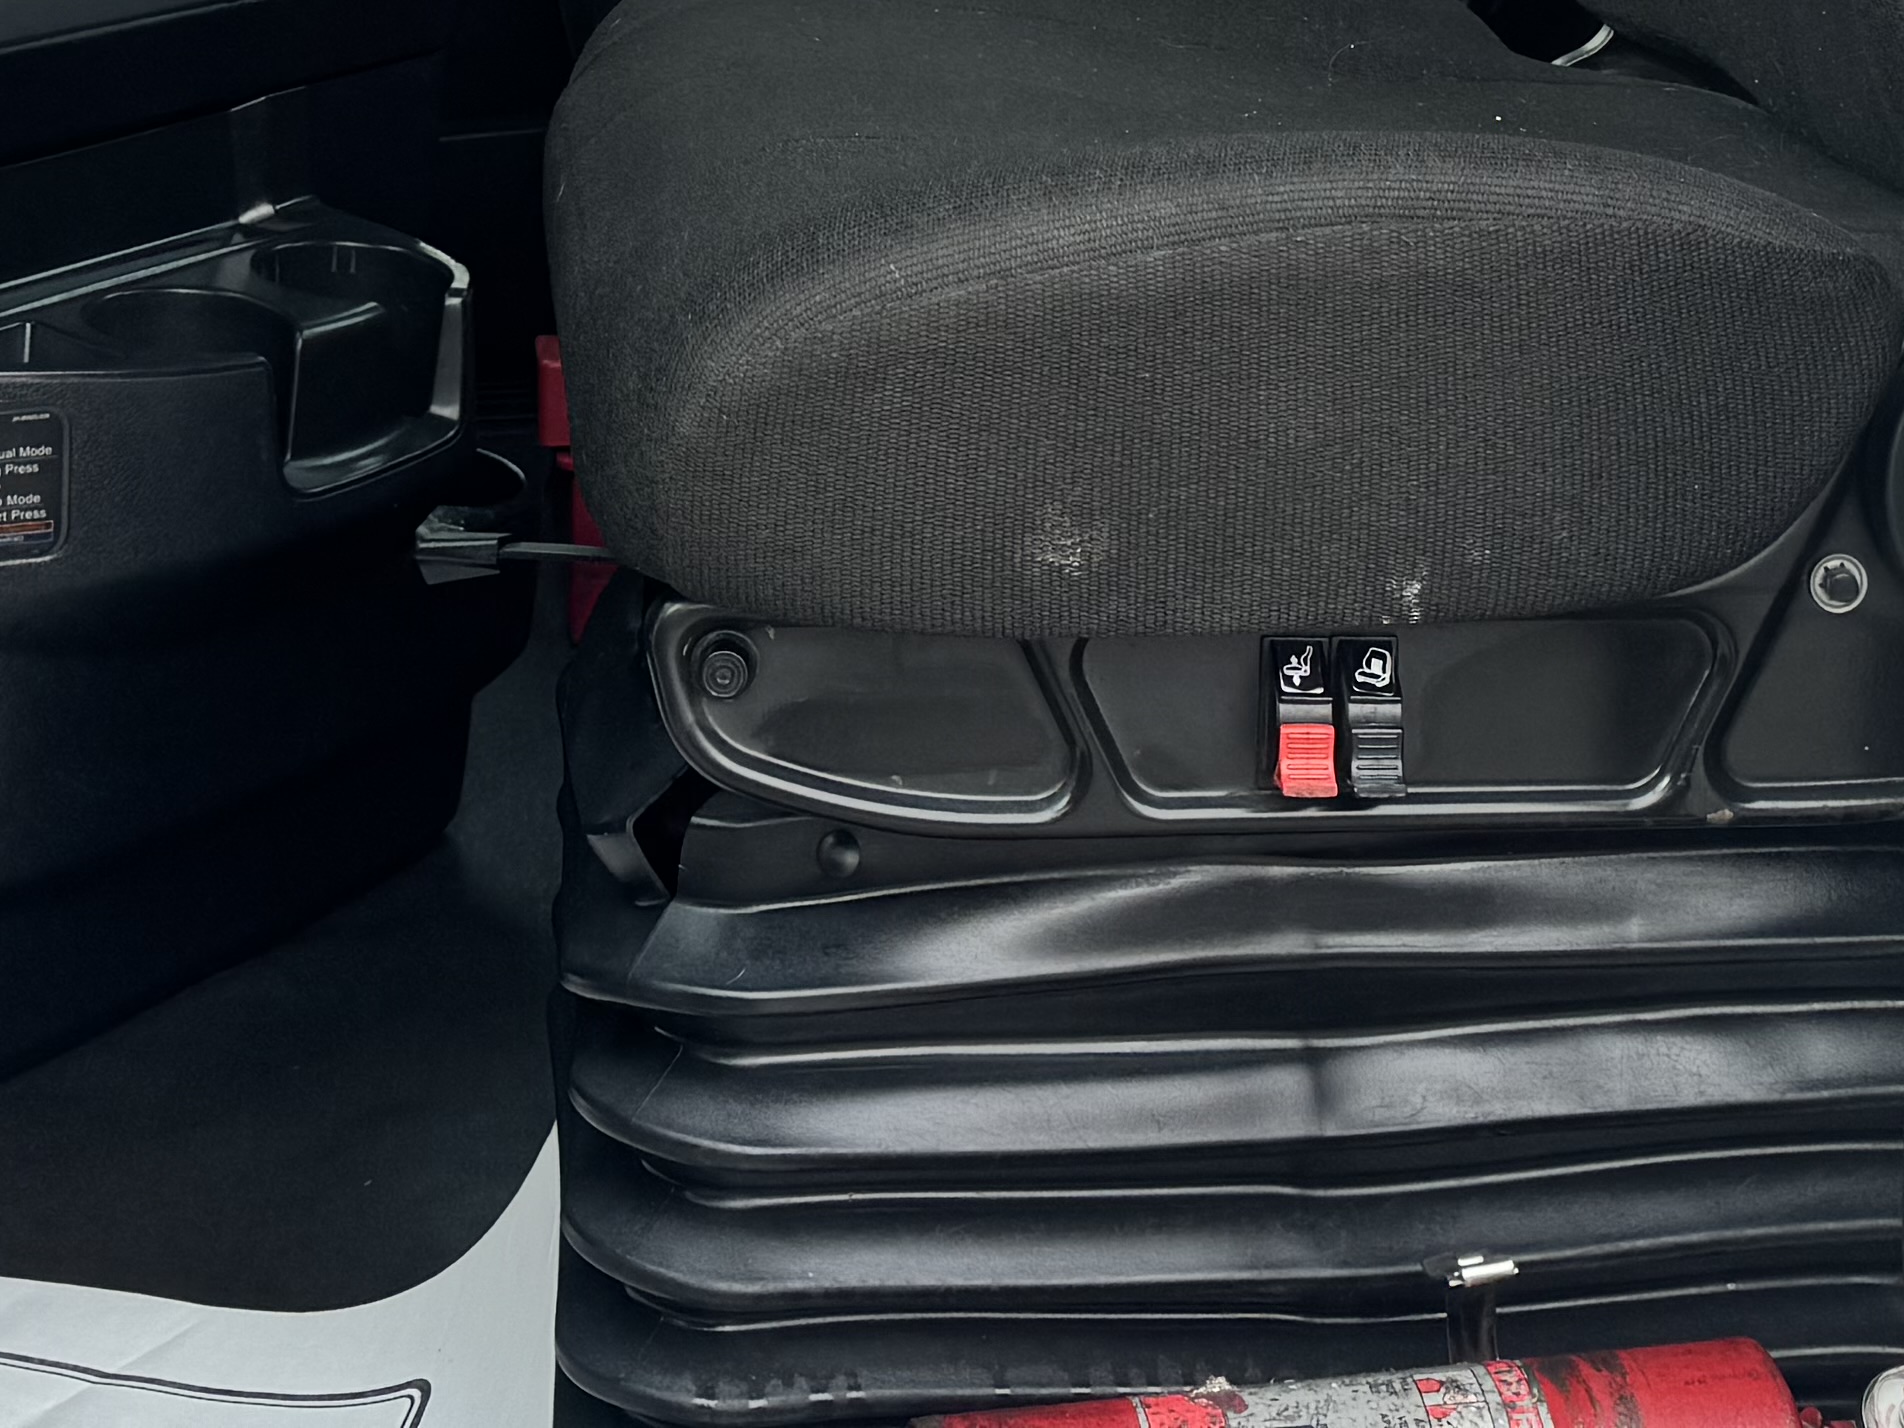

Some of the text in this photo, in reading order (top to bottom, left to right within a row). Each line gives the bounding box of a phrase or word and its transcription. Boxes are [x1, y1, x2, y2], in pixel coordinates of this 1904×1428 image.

[19, 445, 52, 457] Mode
[5, 463, 39, 475] Press
[7, 494, 41, 506] Mode
[11, 508, 46, 520] Press
